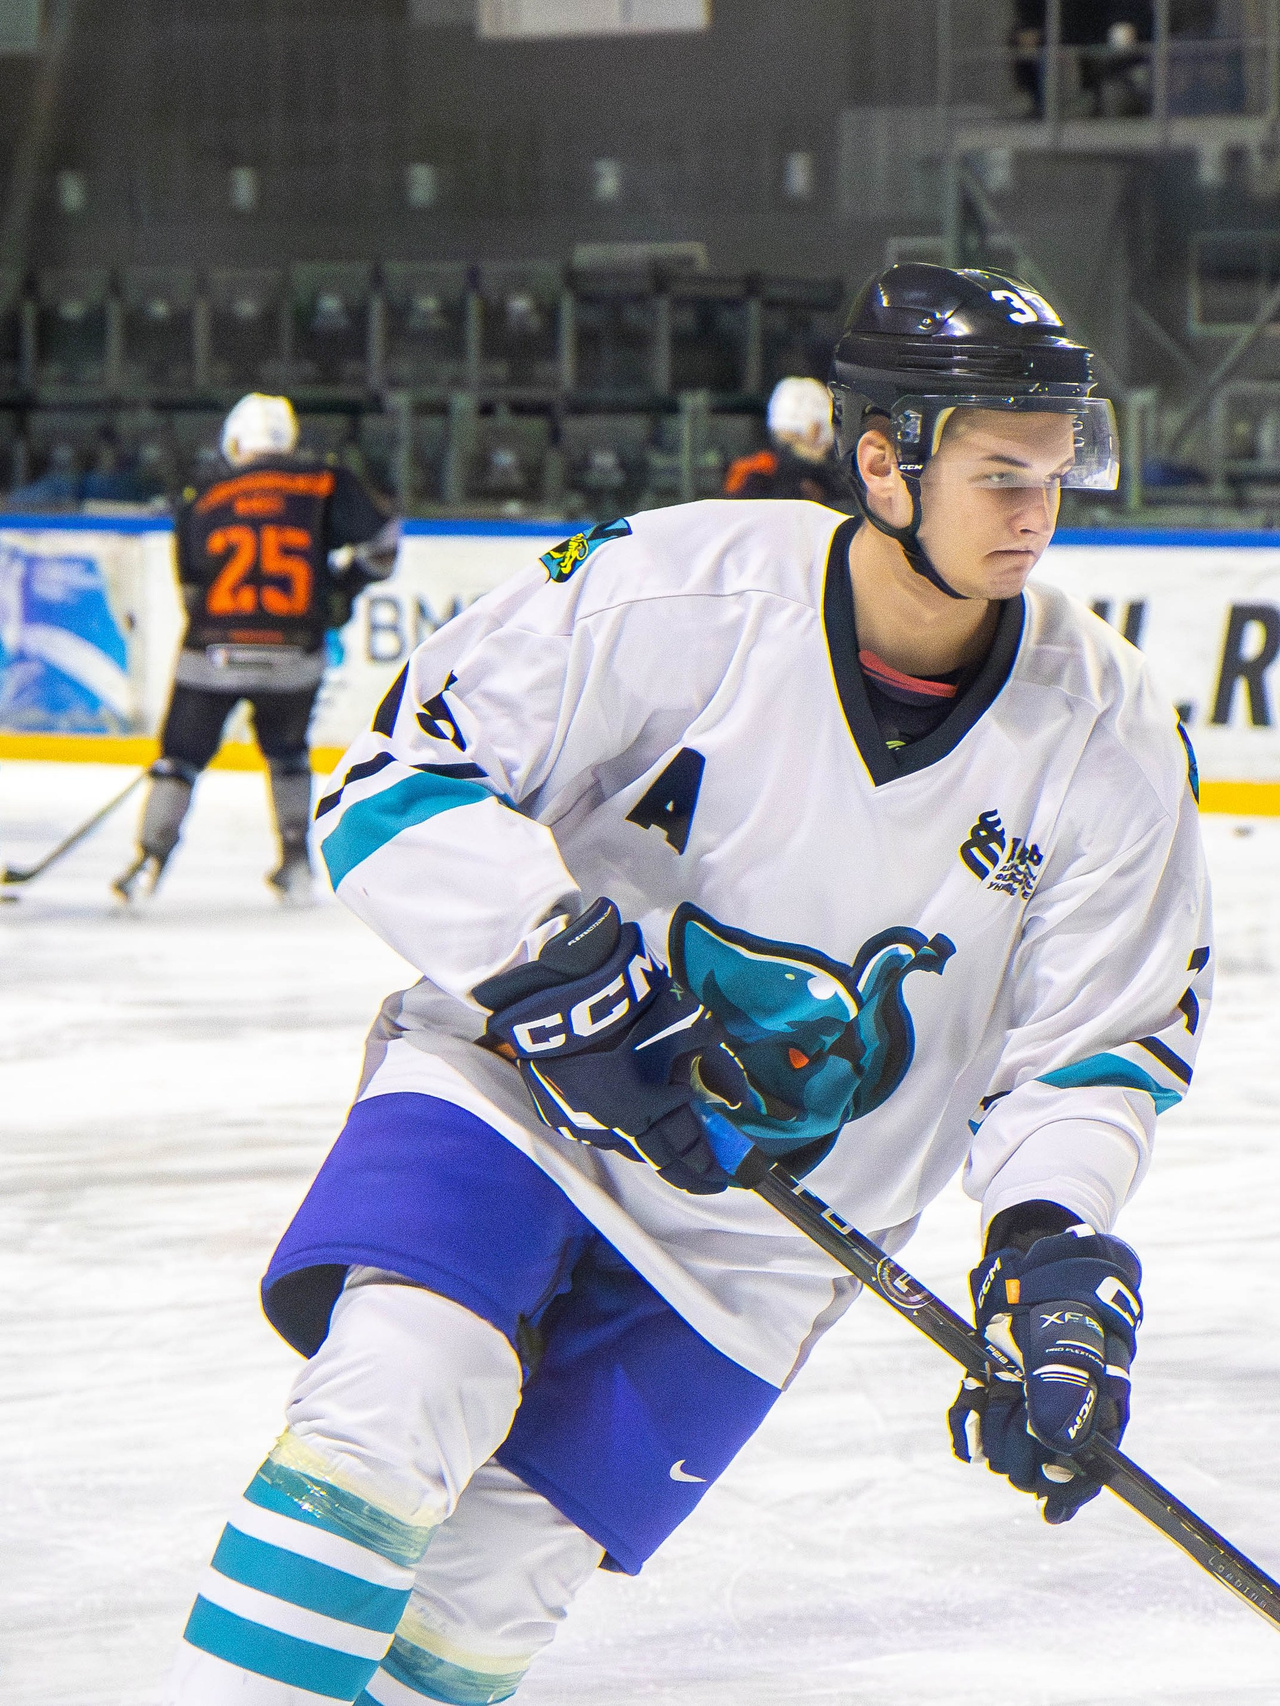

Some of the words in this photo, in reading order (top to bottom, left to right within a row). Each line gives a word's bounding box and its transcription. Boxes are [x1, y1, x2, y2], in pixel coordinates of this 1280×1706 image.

[206, 523, 314, 618] 25
[625, 747, 706, 856] A
[512, 952, 664, 1054] CCM
[978, 1257, 1002, 1310] CCM
[1067, 1389, 1095, 1440] CCM
